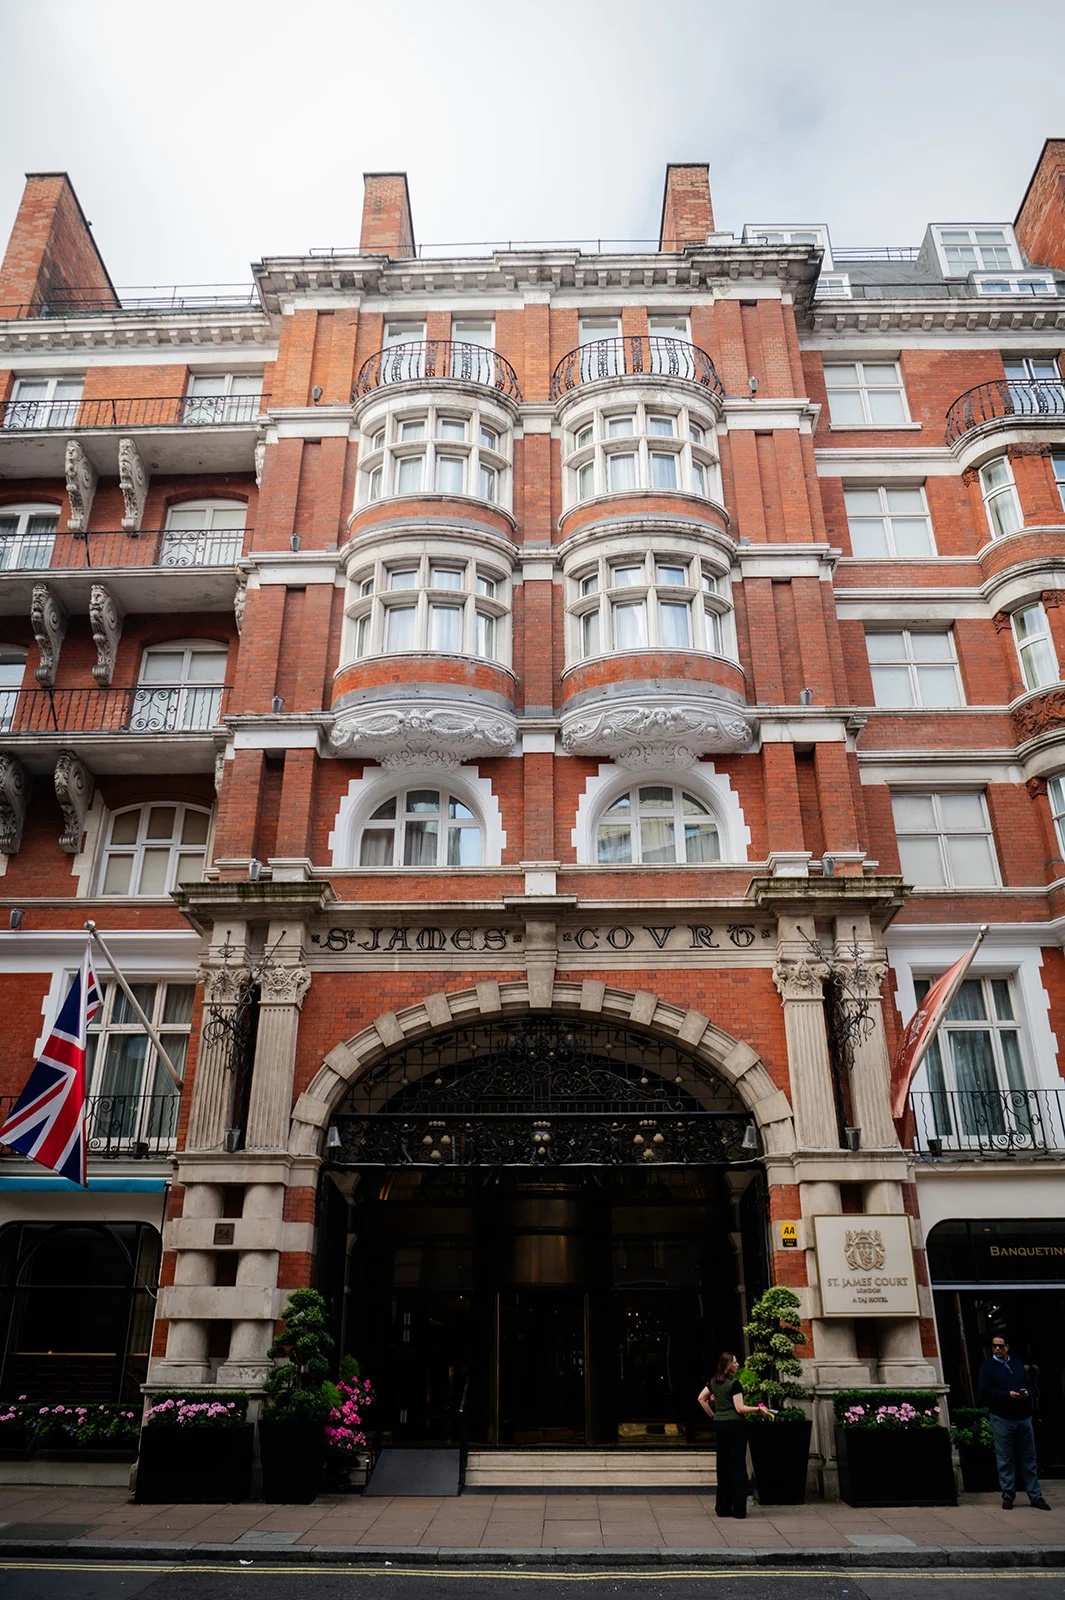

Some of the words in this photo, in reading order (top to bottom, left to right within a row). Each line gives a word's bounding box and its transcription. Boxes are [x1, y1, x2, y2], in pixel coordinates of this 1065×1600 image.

[783, 1226, 795, 1235] AA
[989, 1246, 1065, 1256] BANQUETIN
[874, 1277, 909, 1287] COURT
